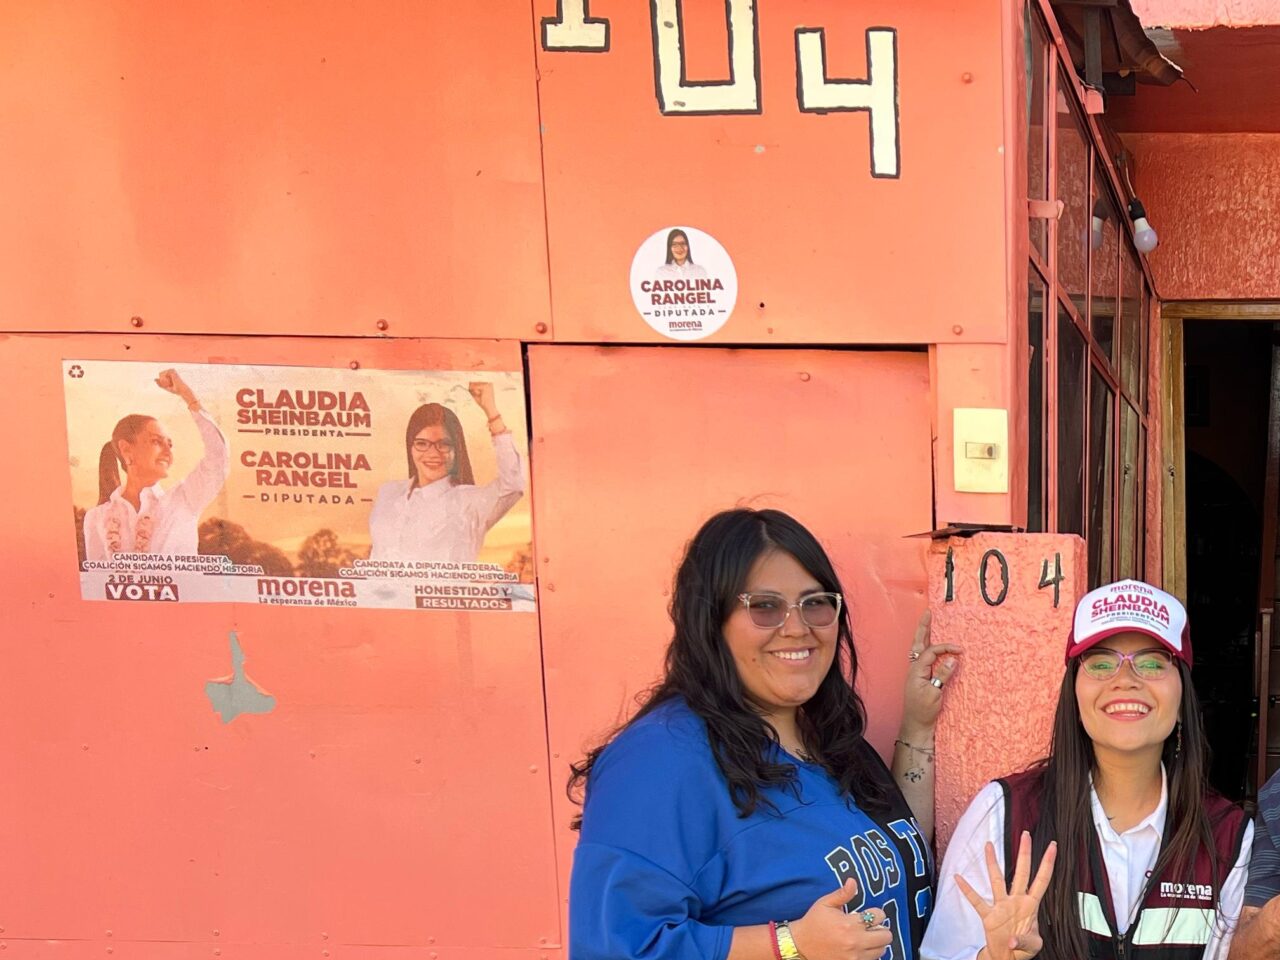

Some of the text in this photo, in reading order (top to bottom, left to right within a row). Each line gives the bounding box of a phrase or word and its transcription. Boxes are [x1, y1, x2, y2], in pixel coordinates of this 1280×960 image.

[641, 278, 724, 292] CAROLINA
[651, 292, 716, 306] RANGEL
[654, 309, 714, 317] DIPUTADA
[668, 320, 702, 328] morena
[236, 388, 370, 412] CLAUDIA
[237, 409, 371, 428] SHEINBAUM
[265, 428, 344, 437] PRESIDENTA
[240, 450, 372, 470] CAROLINA
[256, 470, 357, 488] RANGEL
[261, 493, 354, 504] DIPUTADA
[114, 554, 164, 562] CANDIDATA
[84, 561, 263, 574] COALICIÓN SIGAMOS HACIENDO HISTORIA
[355, 560, 406, 568] CANDIDATA
[416, 562, 460, 571] DIPUTADA
[108, 575, 173, 584] 2 DE JUNIO
[340, 569, 518, 581] COALICIÓN SIGAMOS HACIENDO HISTORIA
[944, 546, 1065, 608] 104
[107, 584, 177, 600] VOTA
[257, 579, 357, 598] morena
[414, 585, 510, 597] HONESTIDAD Y
[1110, 584, 1154, 595] morena
[270, 598, 312, 606] esperanza
[314, 598, 324, 606] de
[327, 598, 357, 606] México
[422, 599, 508, 609] RESULTADOS
[1092, 594, 1170, 616] CLAUDIA
[1091, 604, 1170, 625] SHEINBAUM
[824, 816, 928, 915] BOST
